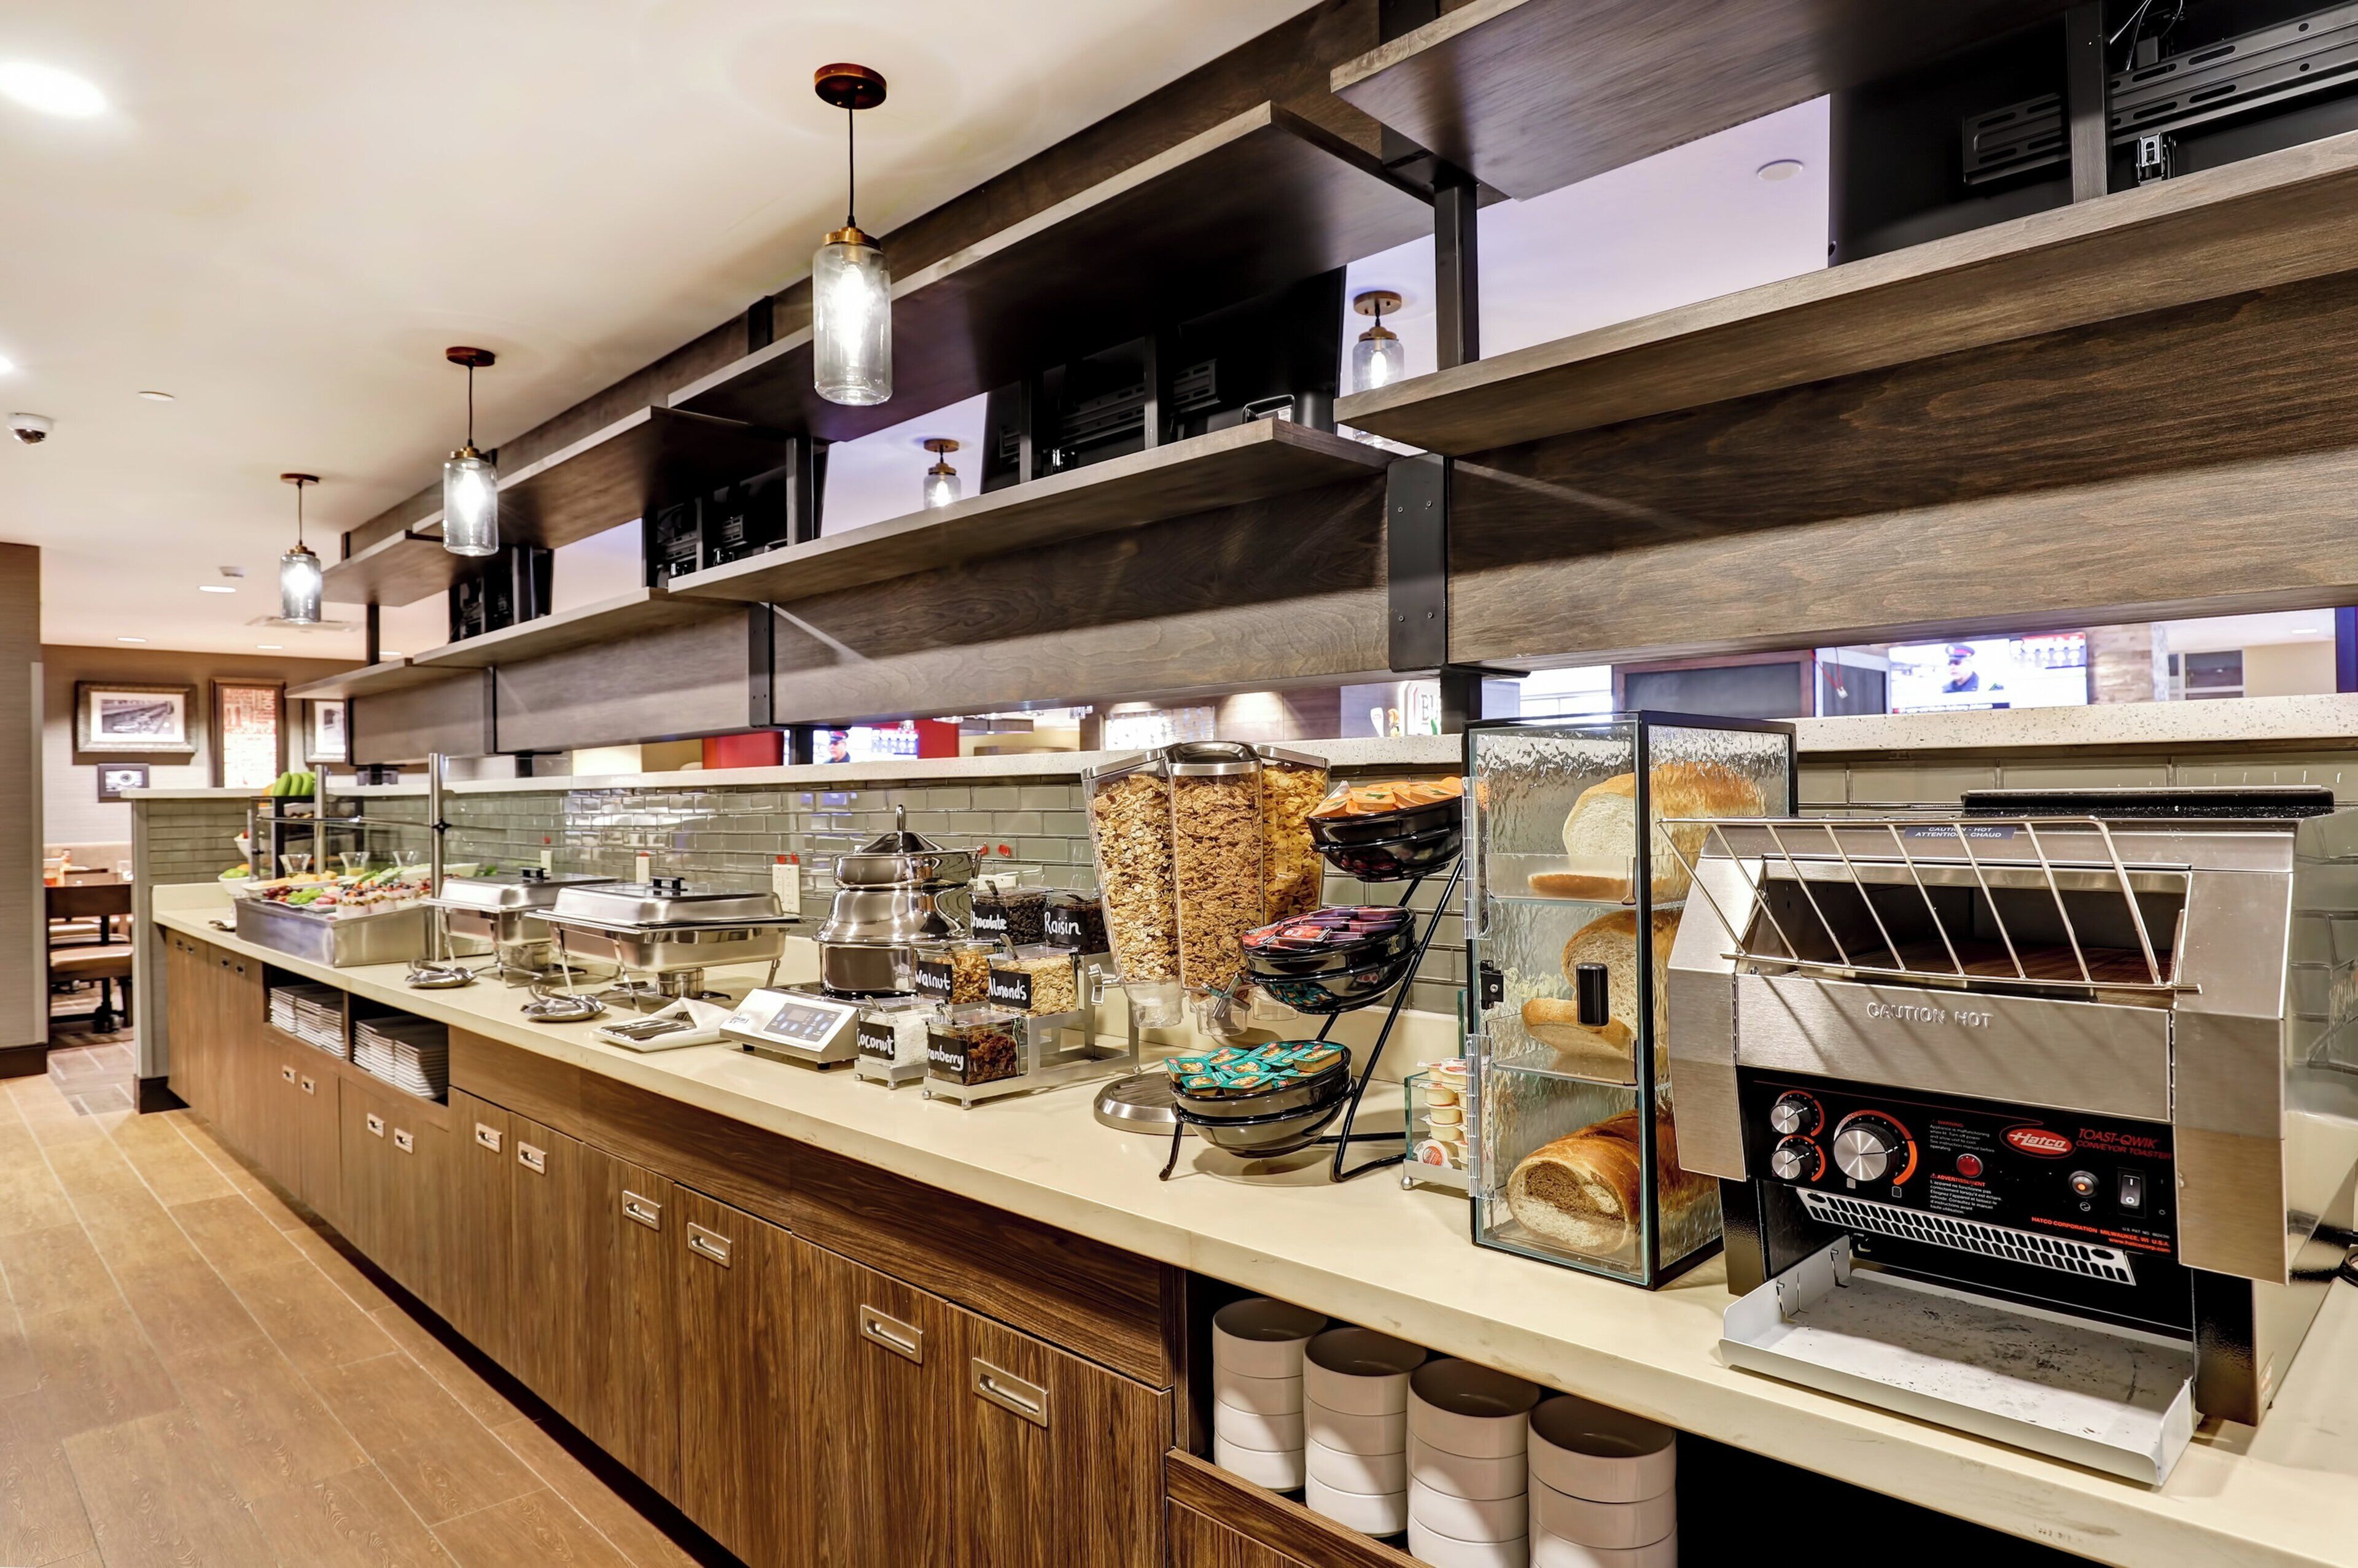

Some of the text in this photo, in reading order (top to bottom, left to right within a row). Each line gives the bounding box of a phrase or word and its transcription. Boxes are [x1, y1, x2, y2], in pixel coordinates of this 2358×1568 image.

[1044, 911, 1082, 936] Raisin
[915, 969, 951, 991] Walnut
[988, 976, 1027, 1001] Almonds
[1867, 1002, 1994, 1028] CAUTION HOT
[856, 1028, 894, 1055] Coconut
[927, 1044, 964, 1071] ranberry
[2009, 1132, 2068, 1152] Hatco
[2079, 1128, 2158, 1149] TOAST-QWIK
[2076, 1139, 2173, 1160] CONVEYOR TOASTER
[1937, 1174, 1985, 1187] ADVERTISSEMENT
[2031, 1216, 2052, 1225] HATCO
[2053, 1221, 2098, 1233] CORPORATION
[2108, 1238, 2171, 1253] www.hatcocorp.com
